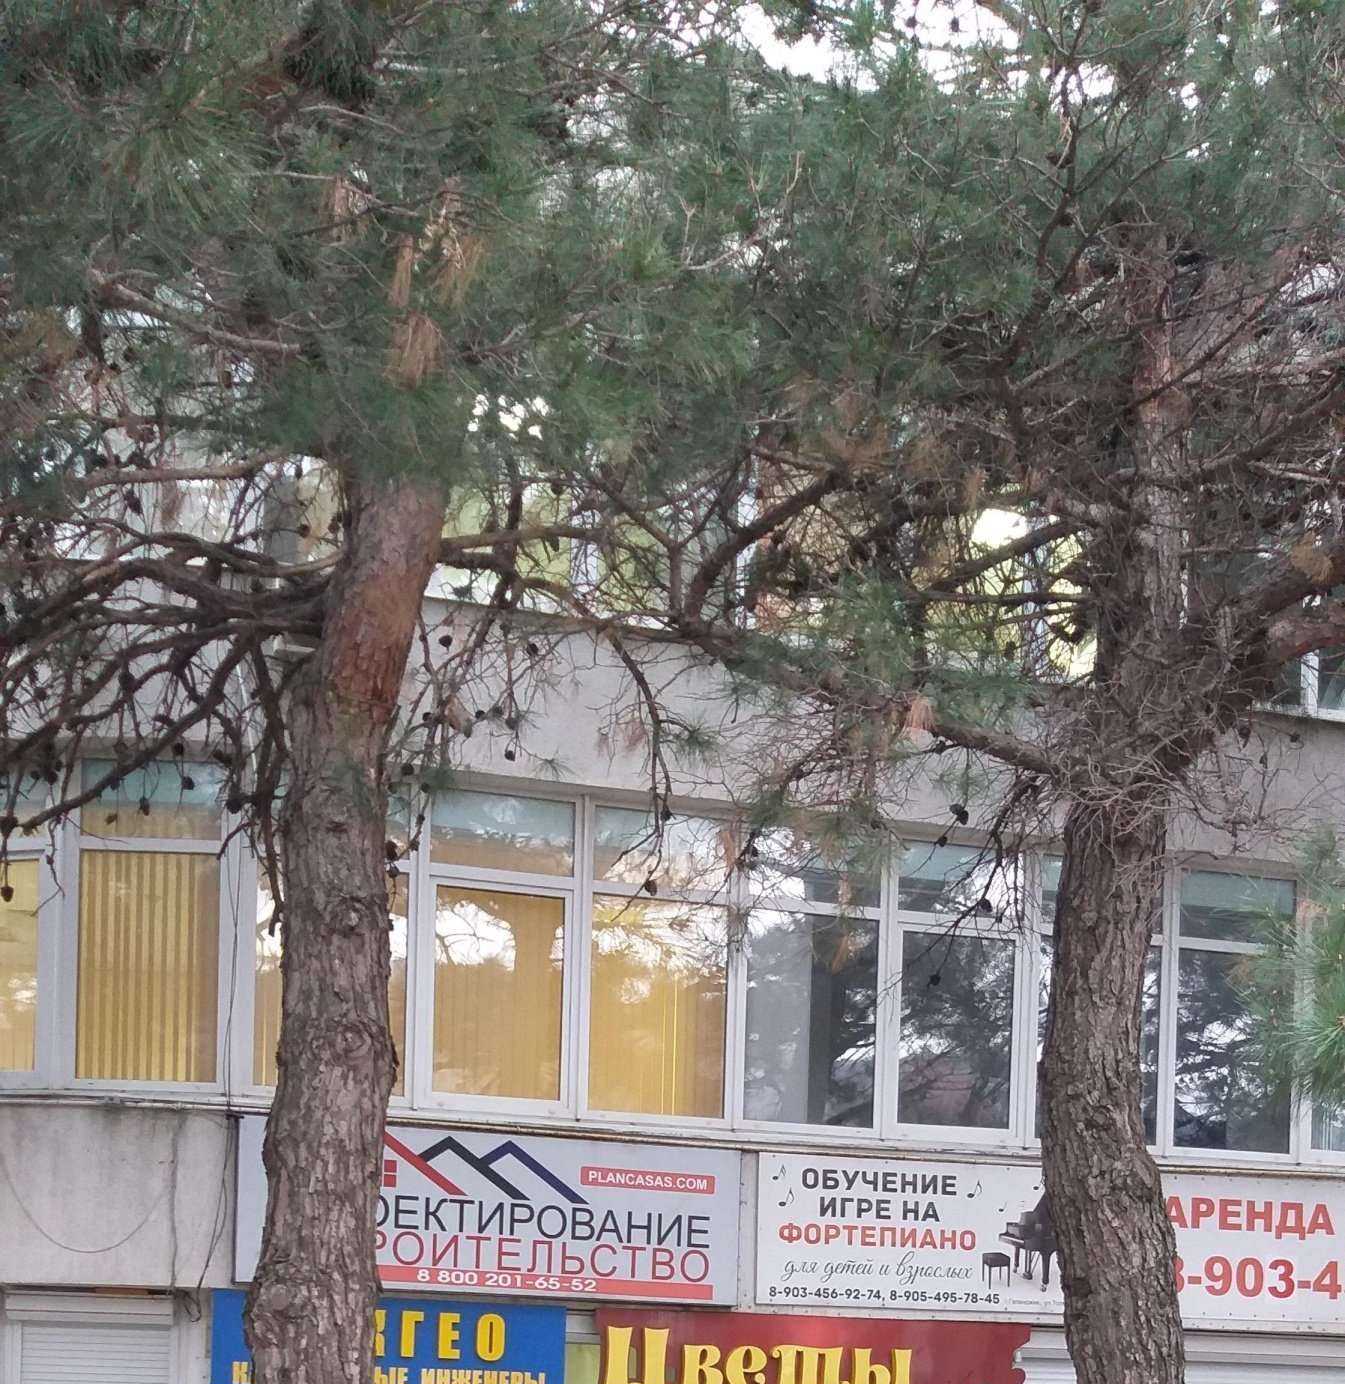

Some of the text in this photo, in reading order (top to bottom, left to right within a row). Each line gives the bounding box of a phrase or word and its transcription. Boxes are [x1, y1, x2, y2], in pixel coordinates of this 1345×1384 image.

[588, 1170, 708, 1191] PLANCASAS.COM
[802, 1168, 957, 1196] ОБУЧЕНИЕ
[376, 1194, 711, 1249] ЕКТИРОВАНИЕ
[819, 1197, 940, 1222] ИГРЕ НА
[1166, 1196, 1335, 1240] АРЕНДА
[779, 1222, 976, 1251] ФОРТЕПИАНО
[376, 1230, 710, 1283] ОИТЕЛЬСТВО
[781, 1251, 973, 1285] для детей и взрослых
[417, 1269, 597, 1292] 8 800 201-65-52
[769, 1286, 885, 1301] 8-903-456-92-74,
[889, 1290, 1000, 1304] 8-905-495-78-45
[375, 1309, 506, 1361] ГЕО
